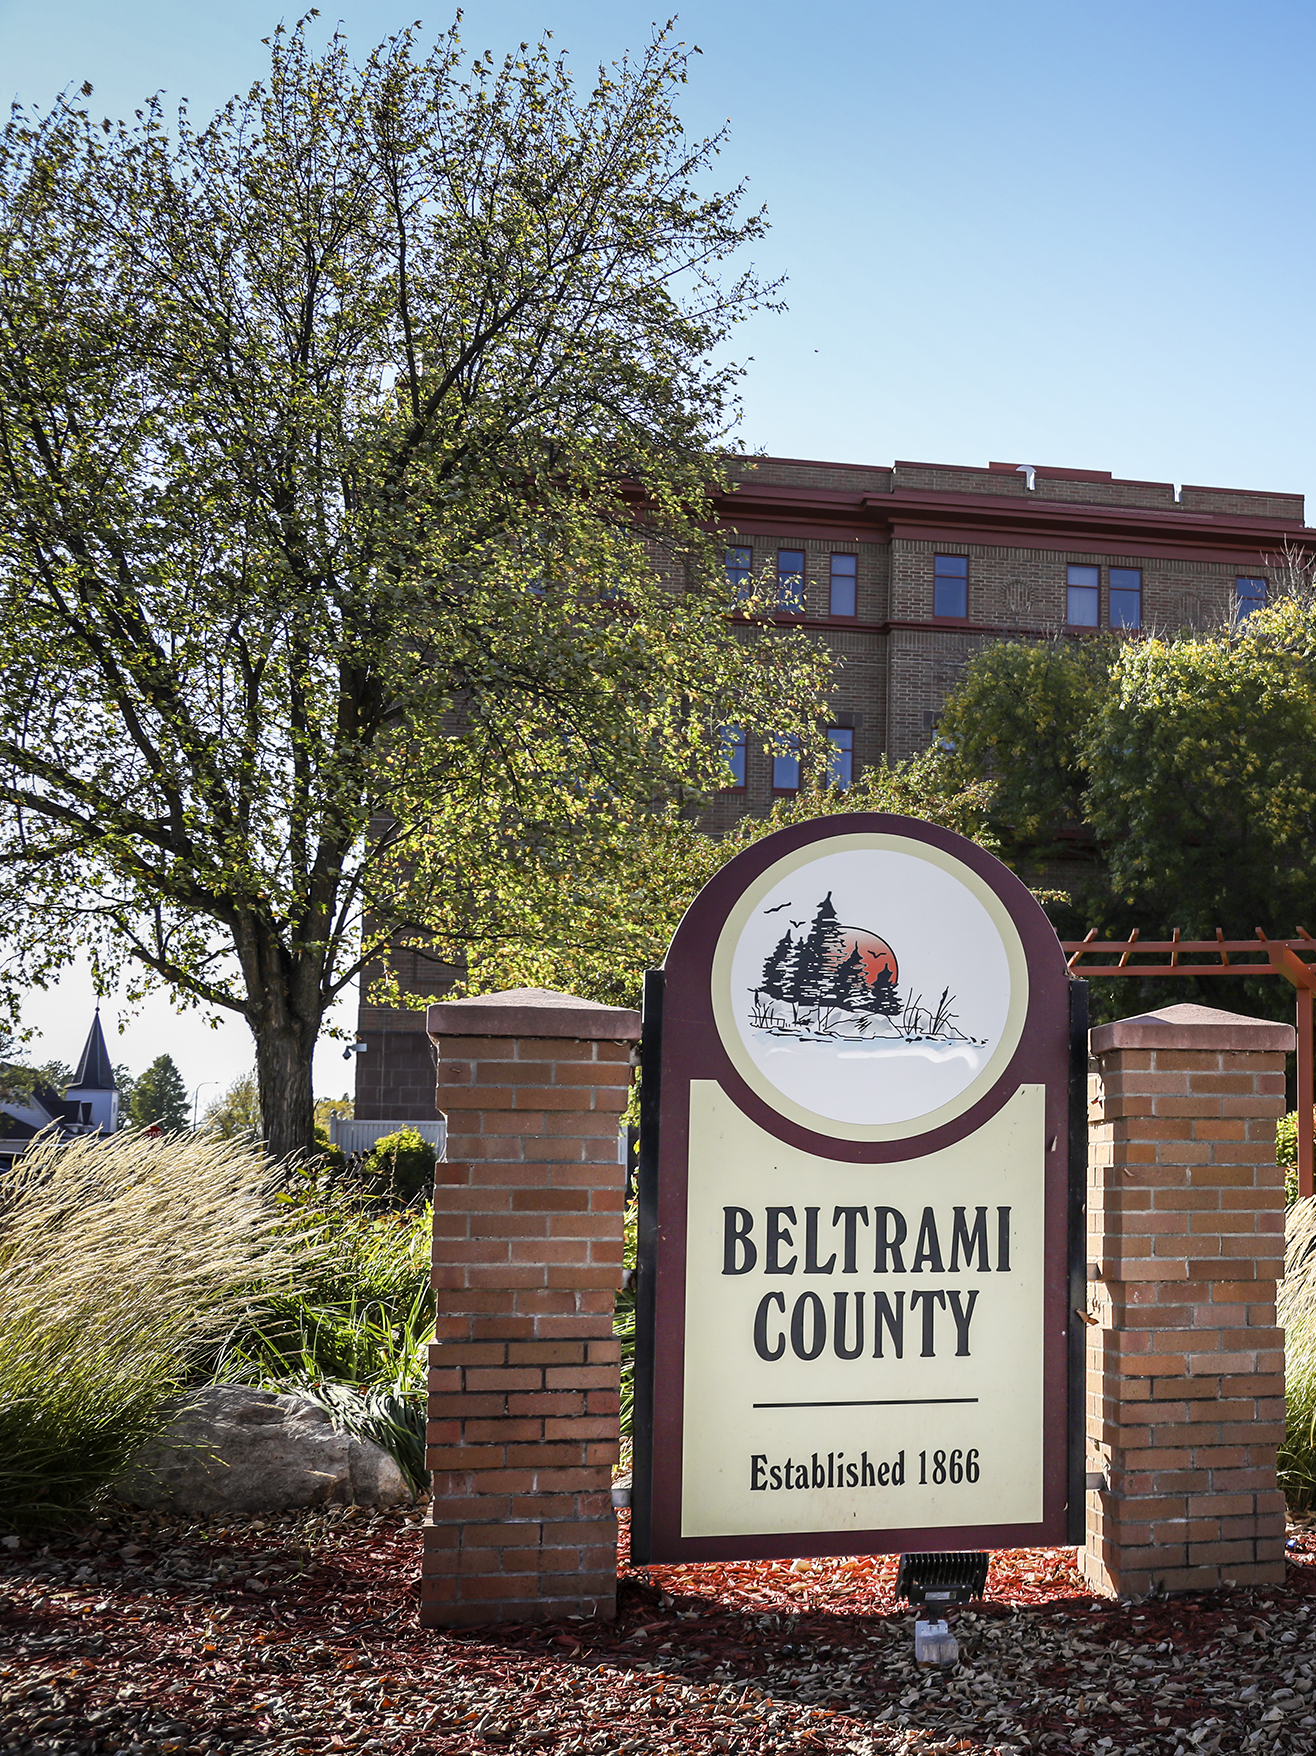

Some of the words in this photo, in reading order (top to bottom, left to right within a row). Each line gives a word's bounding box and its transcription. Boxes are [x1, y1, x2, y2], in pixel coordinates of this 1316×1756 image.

[721, 1205, 1012, 1275] BELTRAMI
[753, 1289, 979, 1361] COUNTY
[750, 1449, 905, 1491] Established
[918, 1448, 980, 1485] 1866
